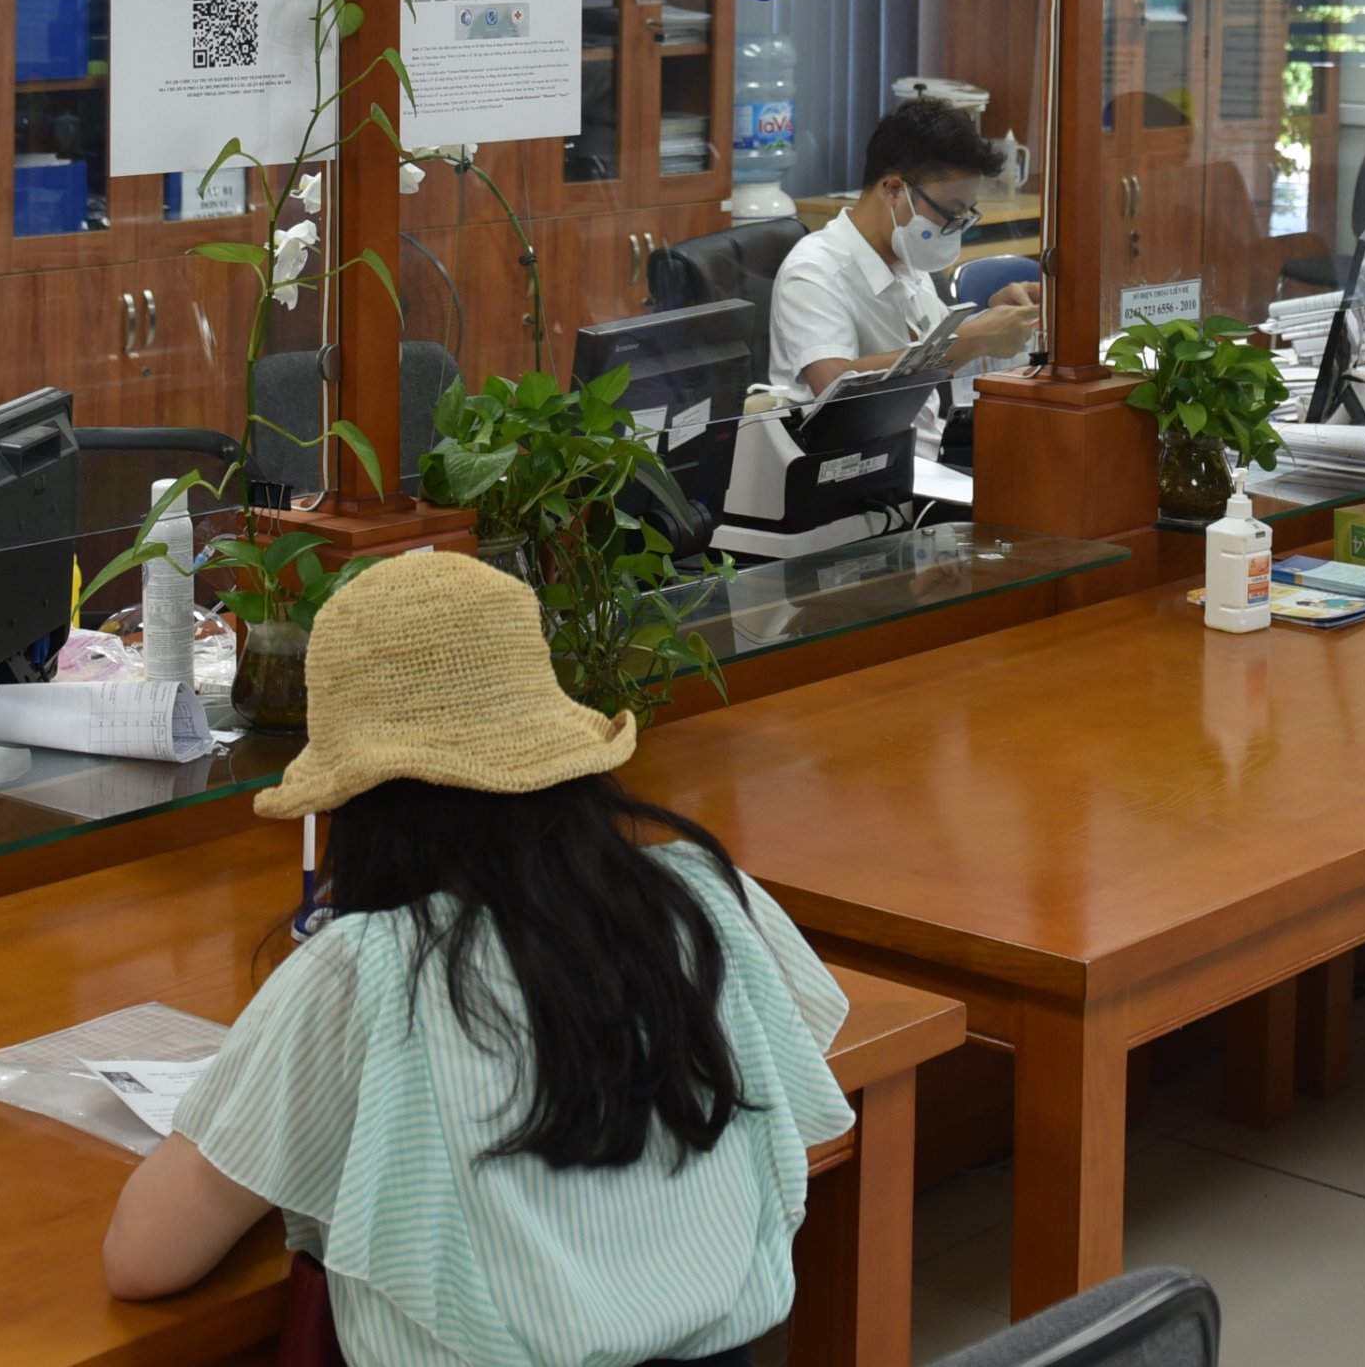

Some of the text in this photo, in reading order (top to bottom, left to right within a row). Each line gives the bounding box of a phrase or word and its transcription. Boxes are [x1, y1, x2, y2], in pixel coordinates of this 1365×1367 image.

[1143, 304, 1156, 316] 723
[1157, 302, 1174, 315] 6556
[1180, 299, 1197, 311] 2010
